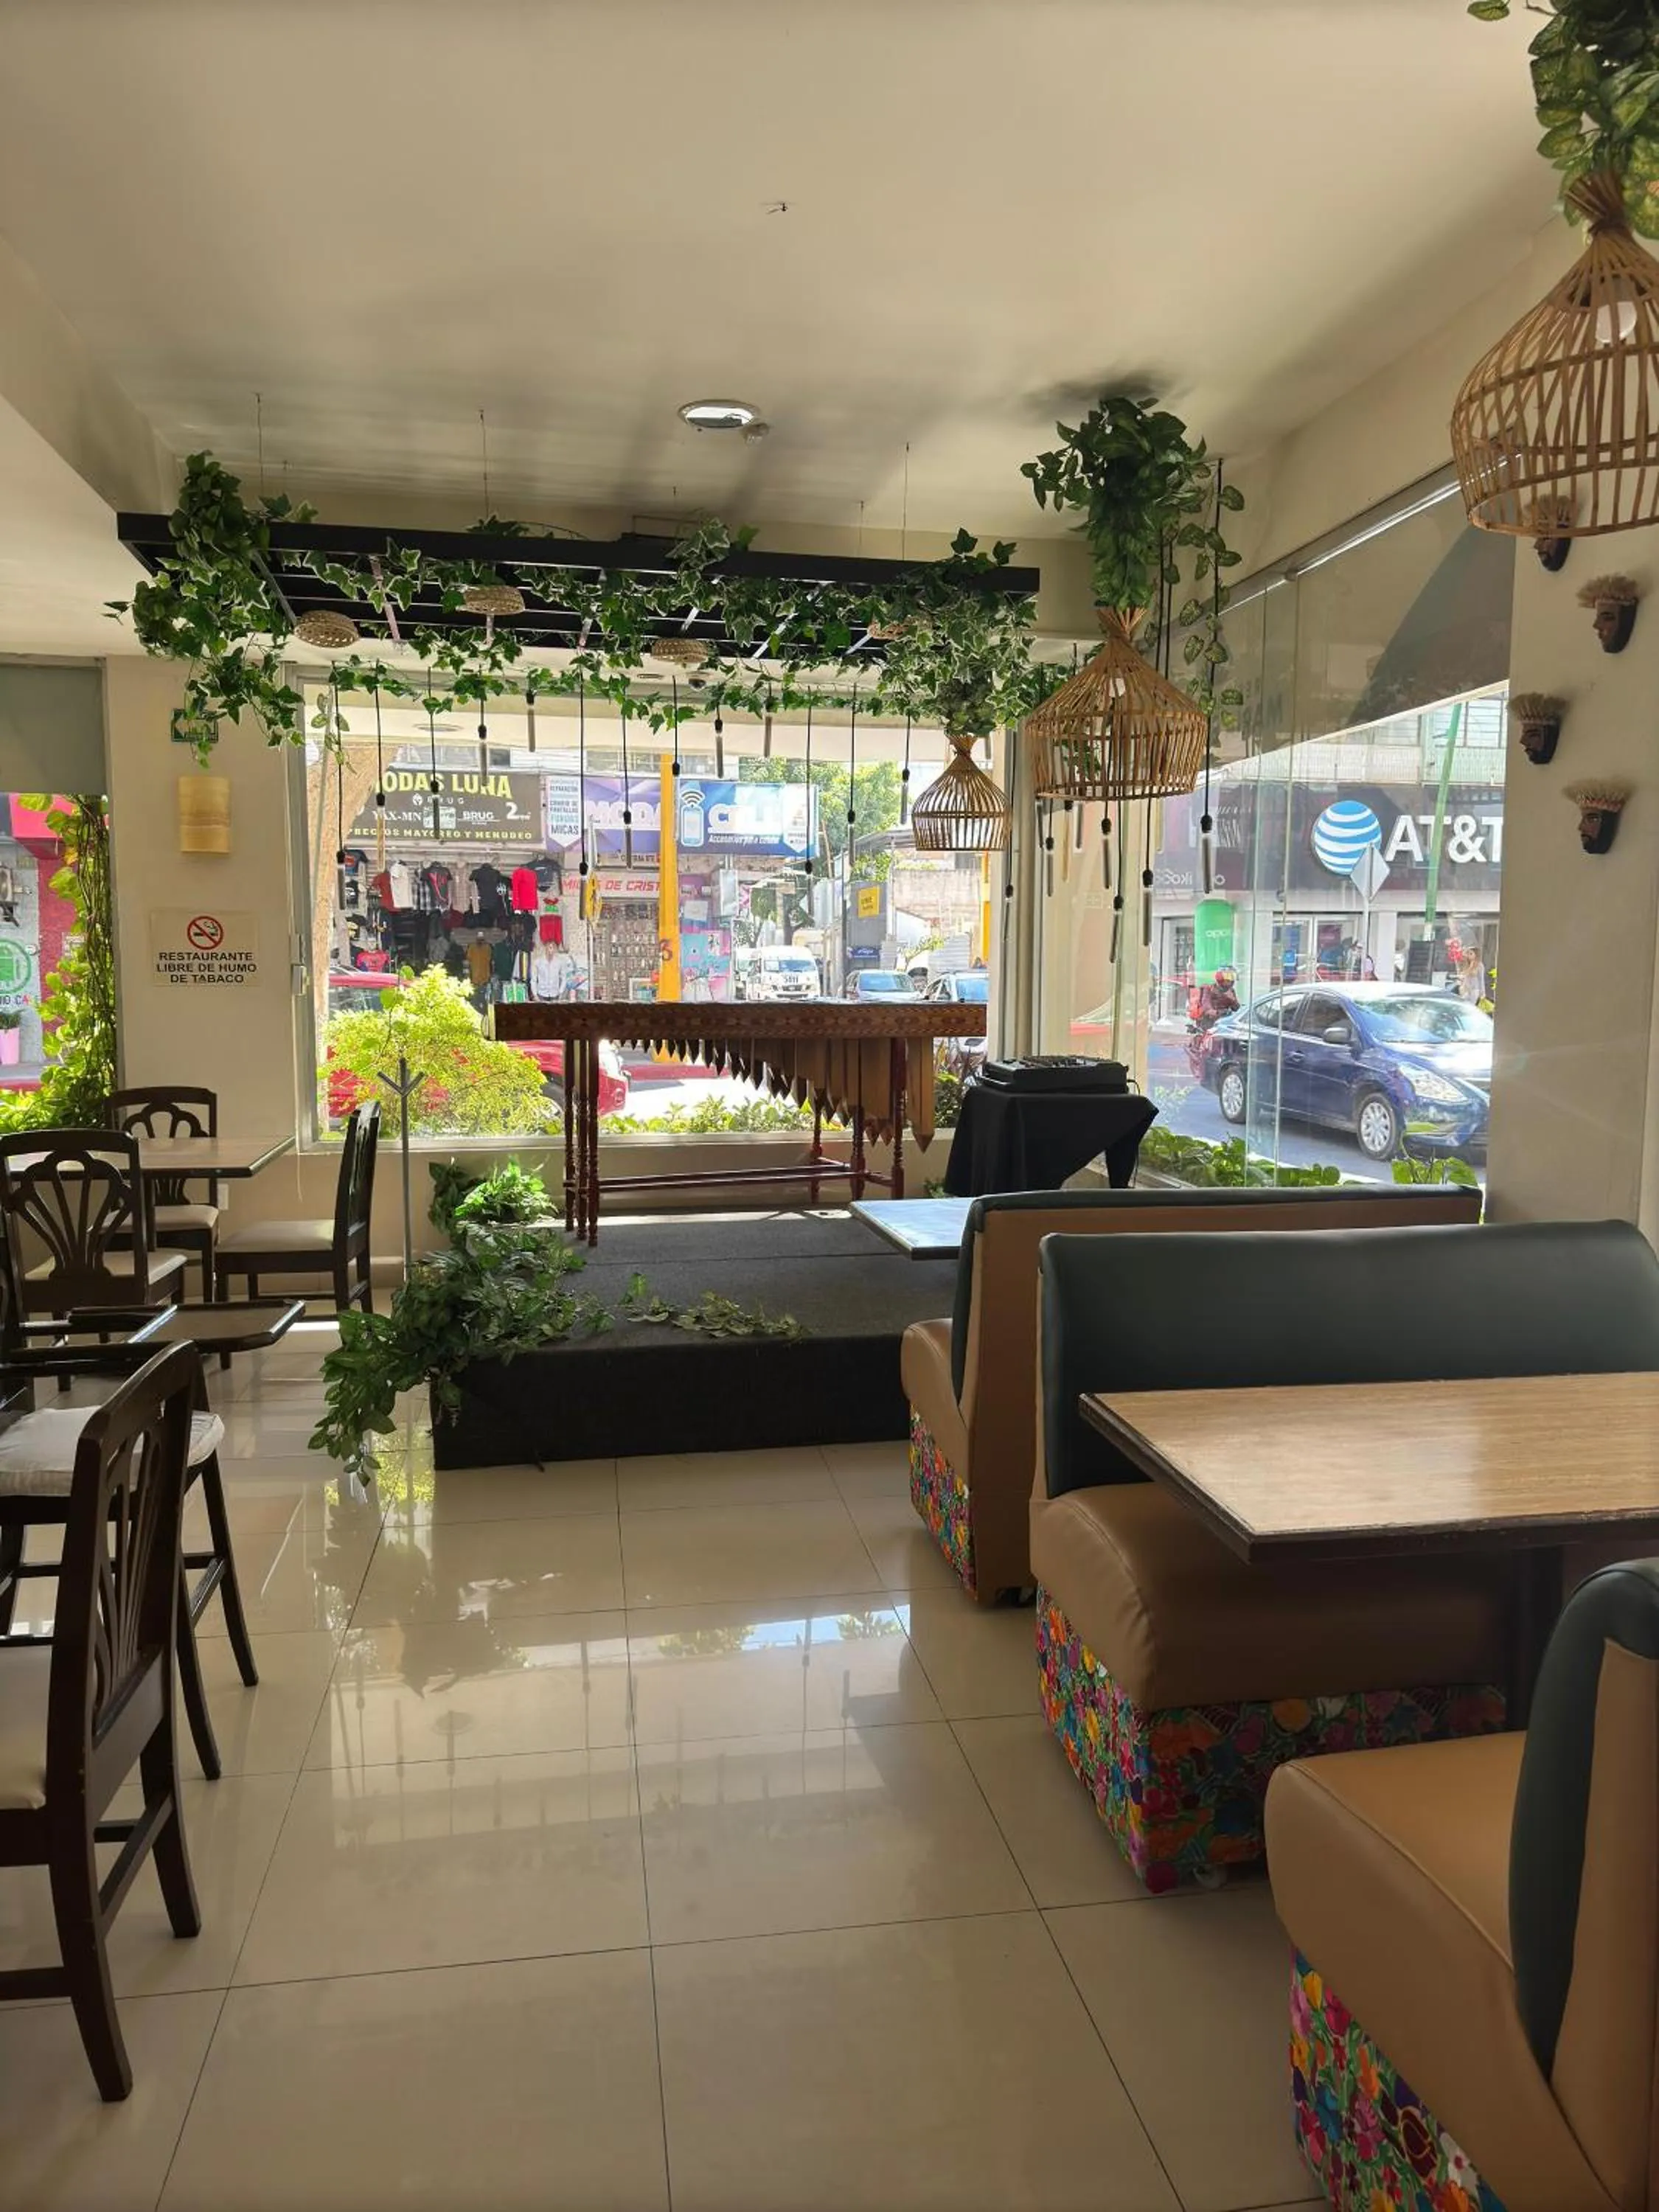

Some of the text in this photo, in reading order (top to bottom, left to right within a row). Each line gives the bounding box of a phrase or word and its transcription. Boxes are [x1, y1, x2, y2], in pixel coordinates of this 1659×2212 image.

[374, 771, 512, 799] ODAS LUNA
[349, 827, 400, 836] RECOS
[475, 831, 532, 840] MENUDEO
[551, 824, 579, 835] MICAS
[1385, 814, 1503, 863] AT&T
[159, 952, 253, 961] RESTAURANTE
[156, 964, 257, 973] LIBRE DE HUMO
[170, 975, 244, 983] DE TABACO
